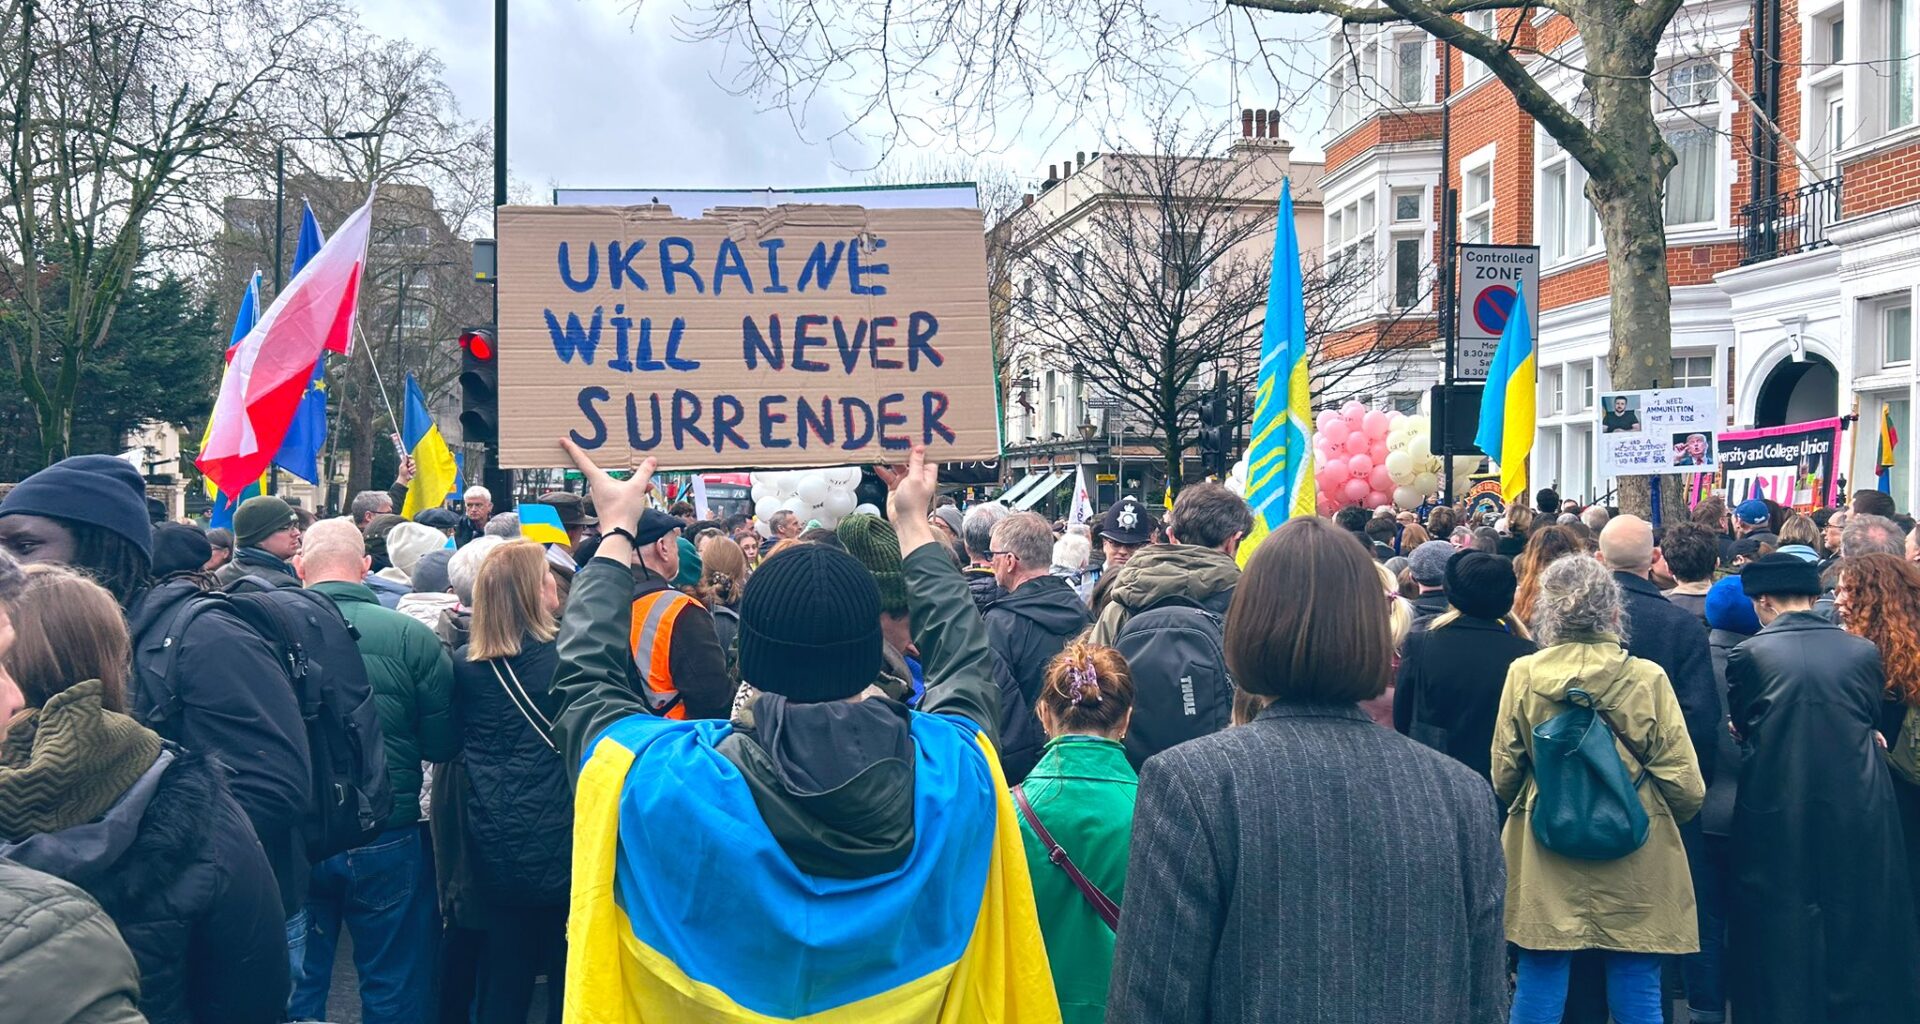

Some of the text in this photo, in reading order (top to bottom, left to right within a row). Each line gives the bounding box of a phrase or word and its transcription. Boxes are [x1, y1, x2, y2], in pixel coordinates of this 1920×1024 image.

[558, 236, 889, 295] UKRAINE
[1466, 251, 1534, 264] Controlled
[1475, 266, 1523, 280] ZONE
[742, 311, 944, 375] NEVER
[1790, 333, 1799, 352] 3
[1646, 405, 1694, 413] AMMUNITION
[1666, 397, 1683, 405] NEED
[569, 385, 957, 453] SURRENDER
[1747, 445, 1764, 461] and
[1764, 443, 1799, 461] College
[1800, 438, 1829, 455] Union
[733, 489, 746, 498] 70
[1180, 675, 1196, 715] THULE
